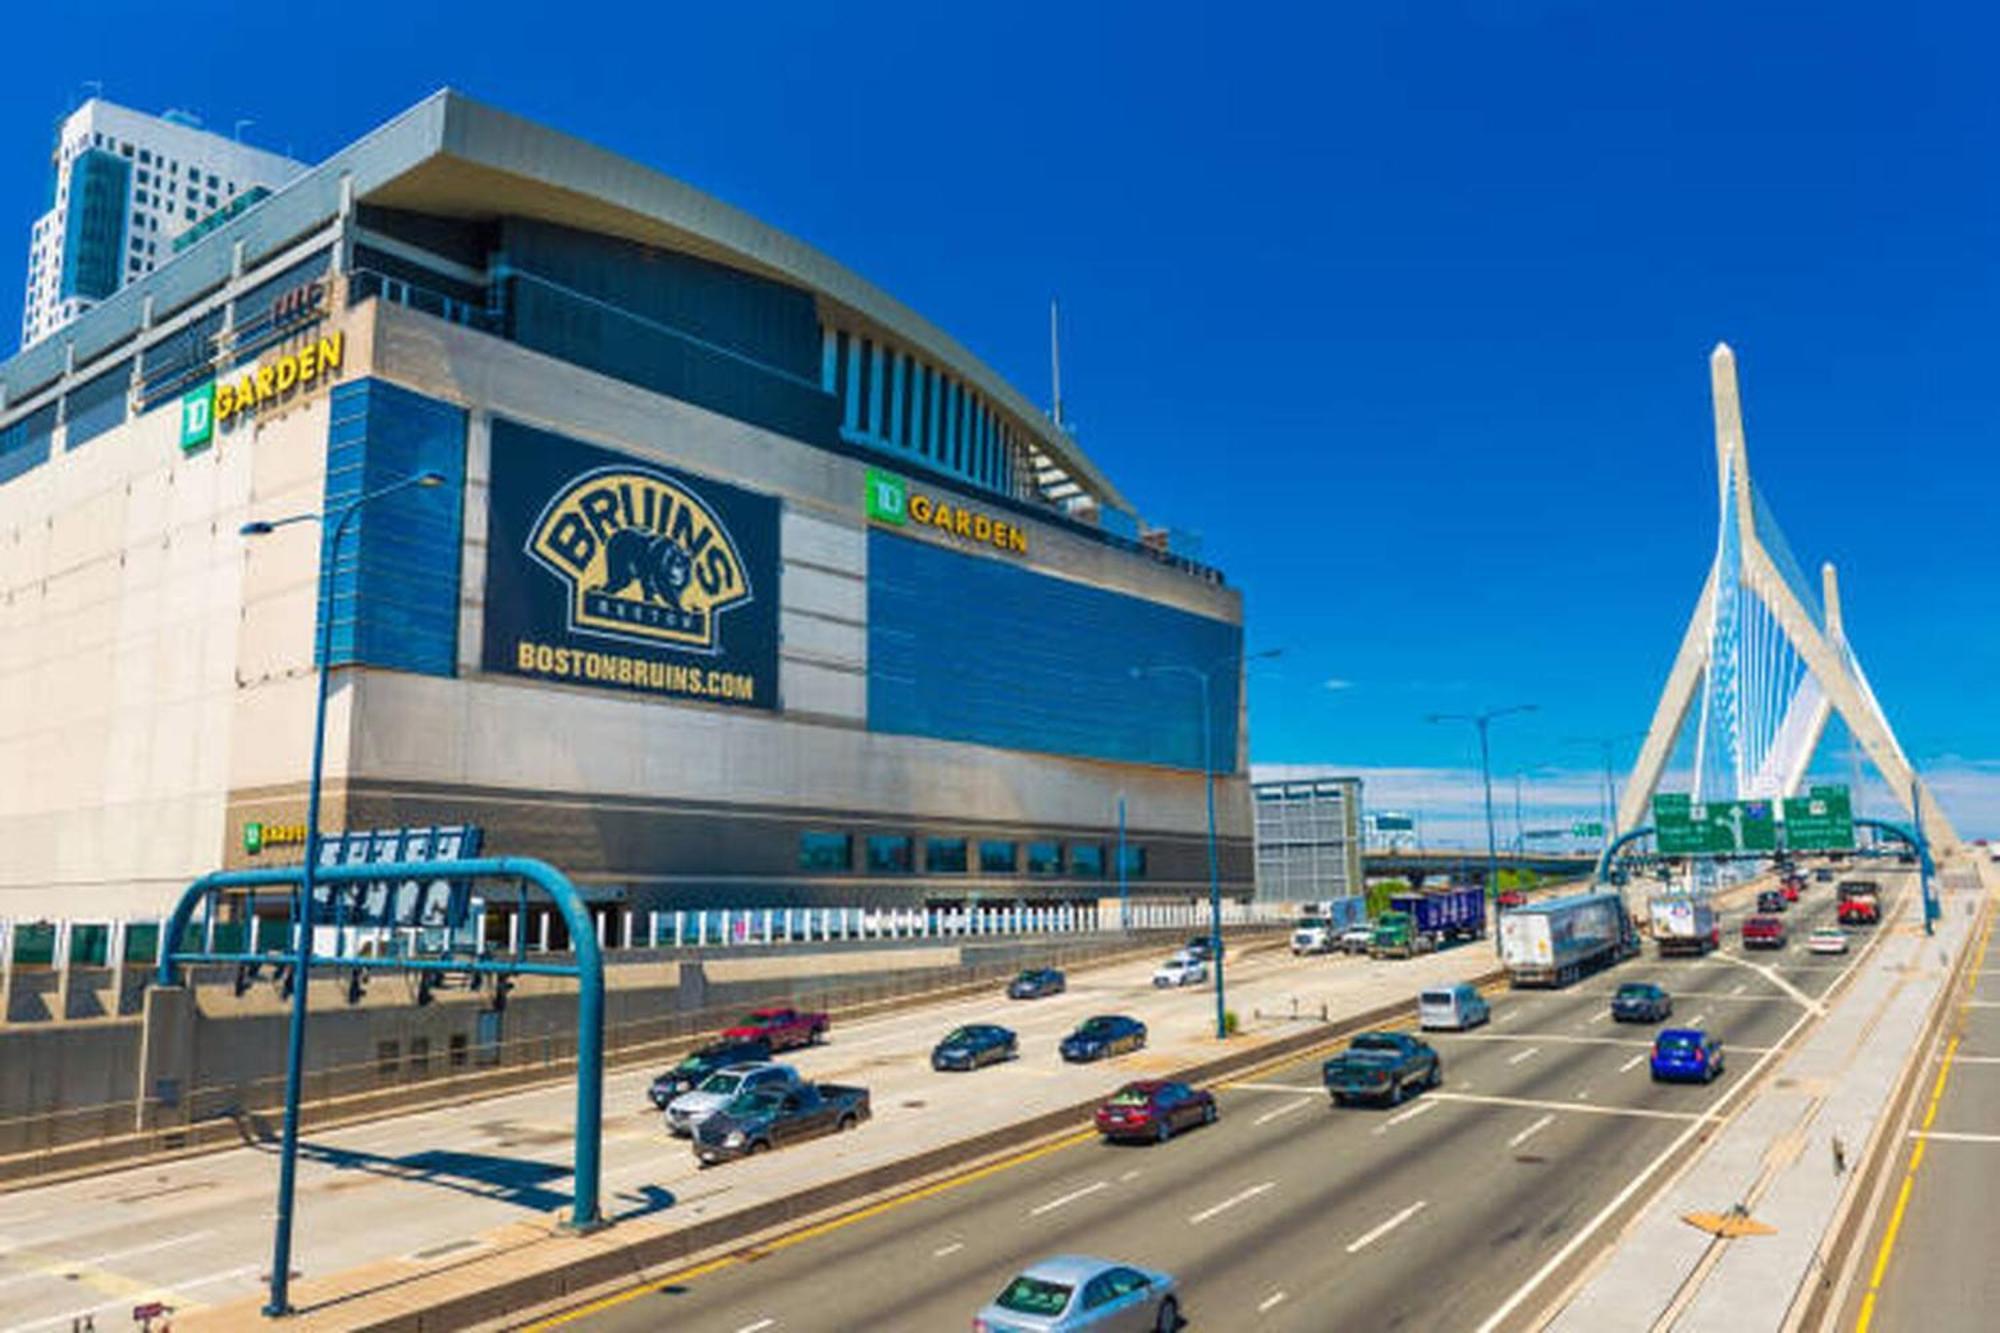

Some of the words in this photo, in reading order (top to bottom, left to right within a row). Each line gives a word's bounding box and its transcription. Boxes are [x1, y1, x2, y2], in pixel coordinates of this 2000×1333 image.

[215, 330, 342, 420] GARDEN
[545, 483, 735, 597] BRUINS
[875, 482, 902, 514] TD
[909, 495, 1027, 554] GARDEN
[518, 641, 754, 700] BOSTONBRUINS.COM
